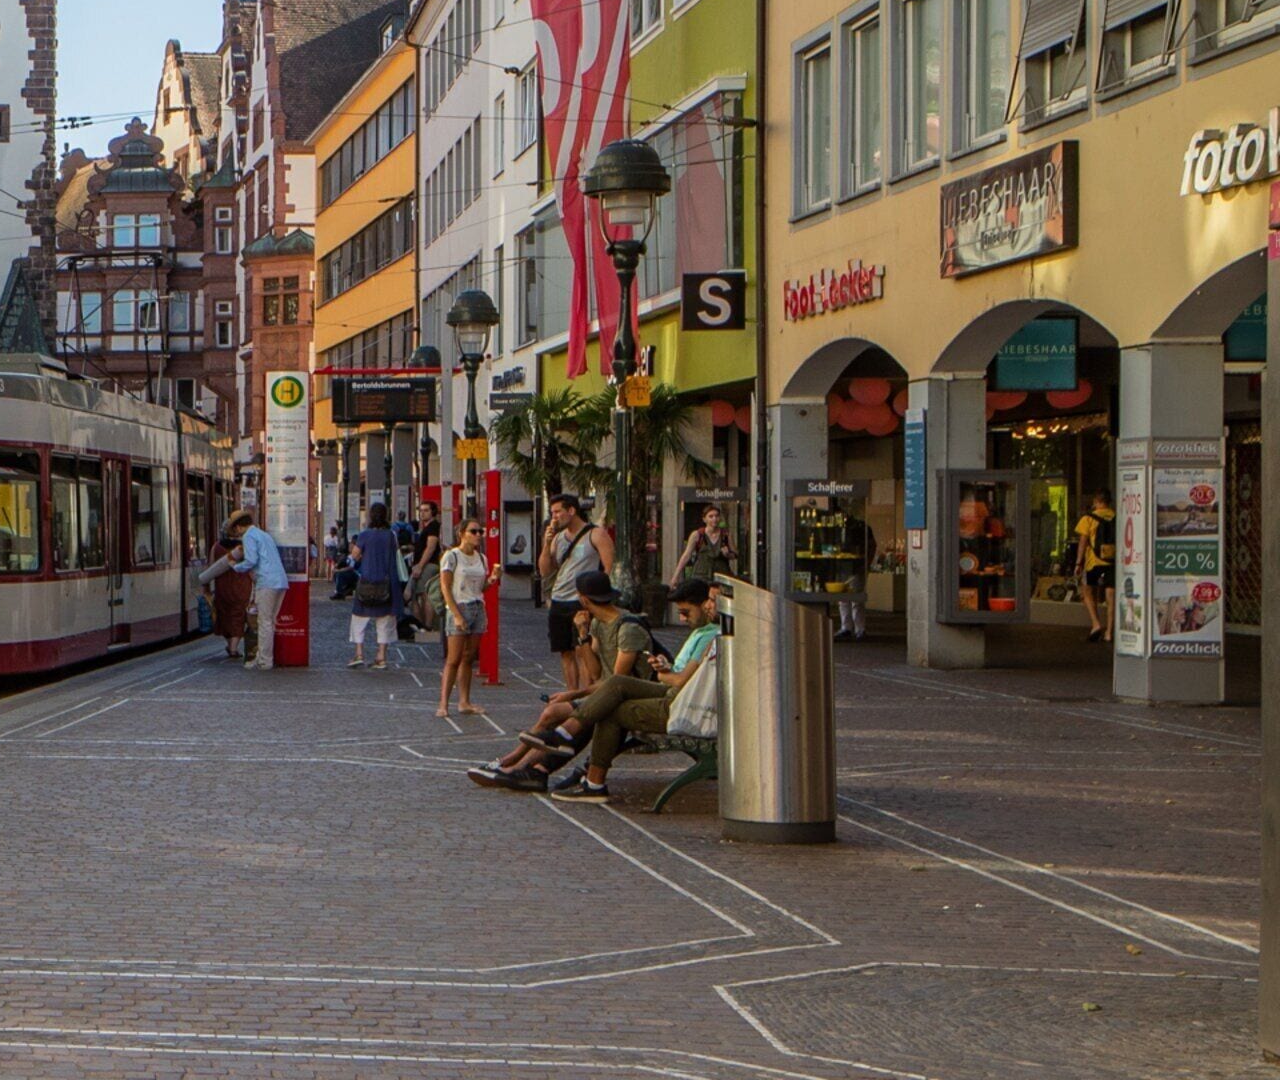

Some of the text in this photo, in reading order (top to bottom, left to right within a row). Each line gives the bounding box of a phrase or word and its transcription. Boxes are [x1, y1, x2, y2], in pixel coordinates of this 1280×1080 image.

[943, 162, 1056, 230] LIEBESHAAR
[698, 277, 732, 325] S
[783, 262, 880, 322] Foot Locker
[1155, 443, 1217, 453] fotoklick
[1196, 552, 1215, 570] %
[1153, 642, 1220, 655] fotoklick
